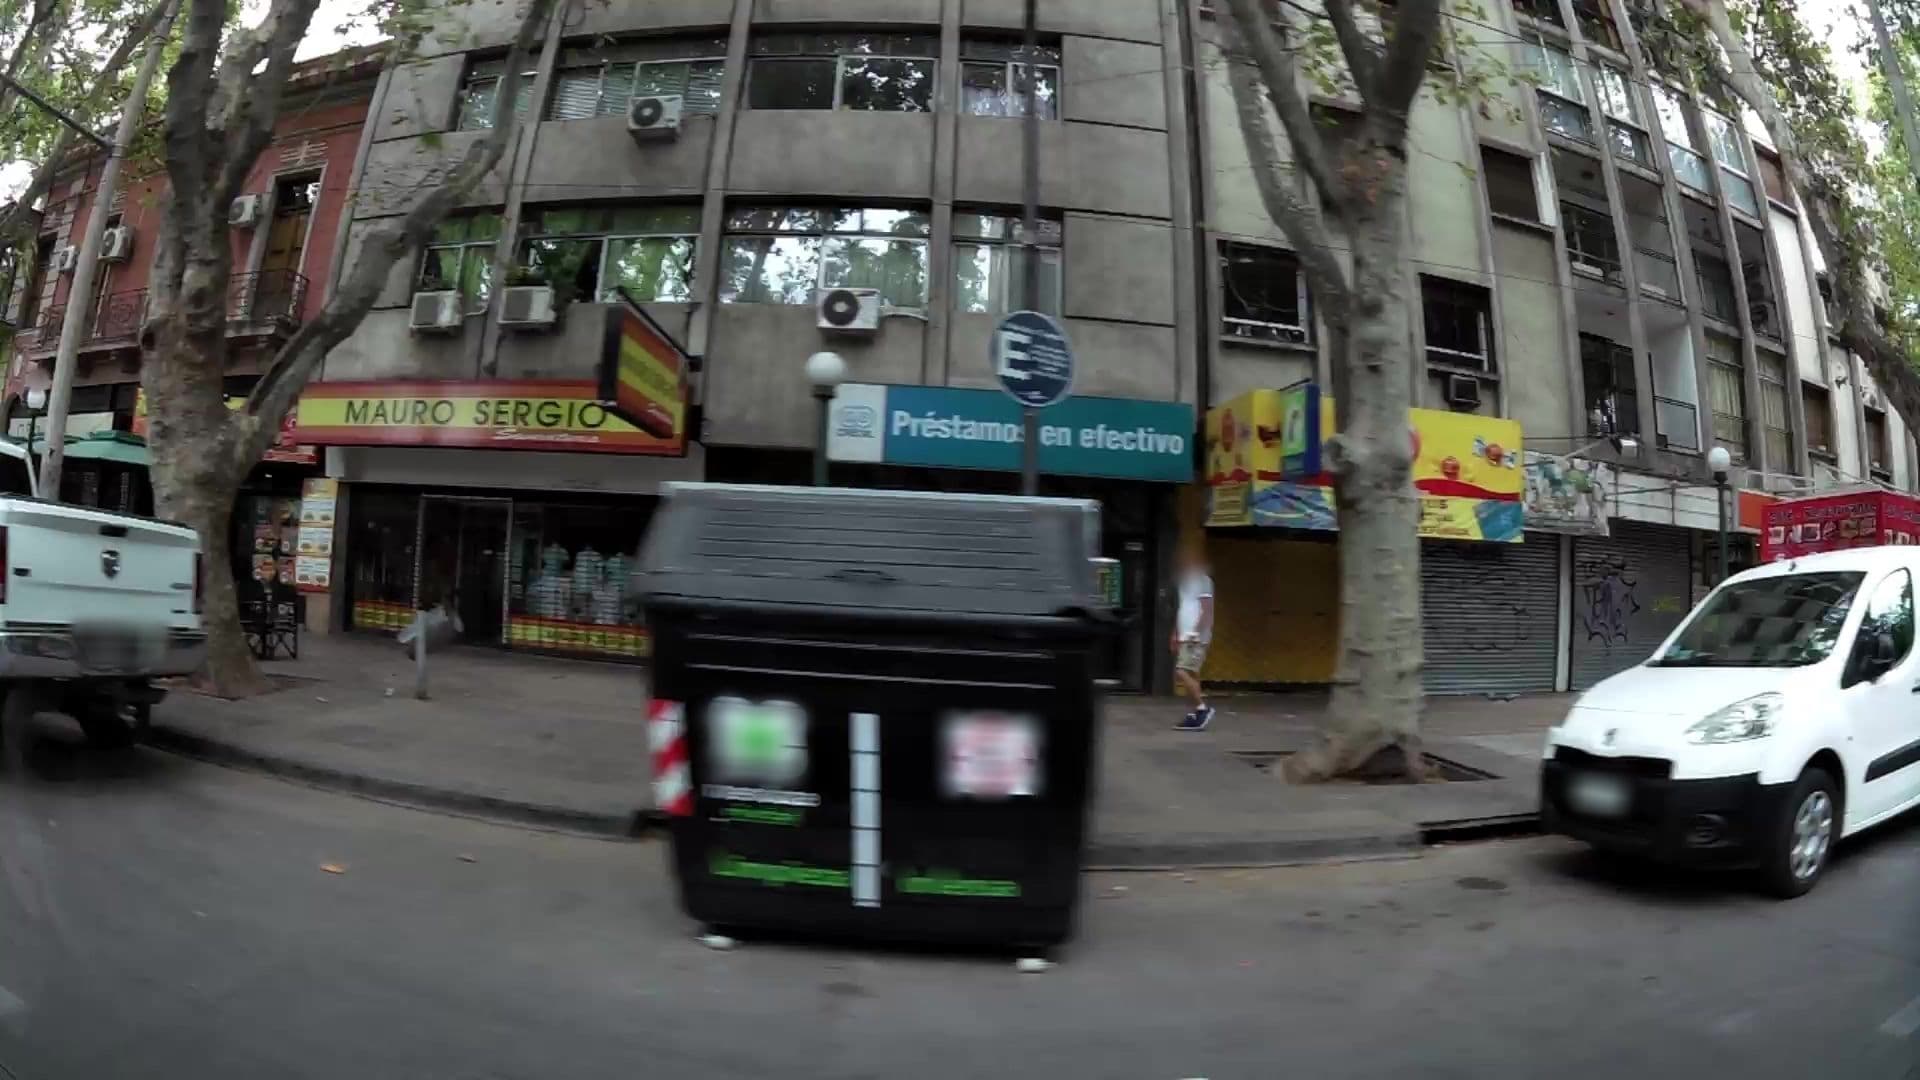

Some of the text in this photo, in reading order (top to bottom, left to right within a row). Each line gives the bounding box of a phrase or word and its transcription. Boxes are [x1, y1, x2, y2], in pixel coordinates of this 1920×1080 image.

[996, 330, 1032, 380] E
[345, 399, 607, 429] MAURO SERGIO
[1040, 425, 1072, 447] en
[1079, 422, 1185, 456] efectivo
